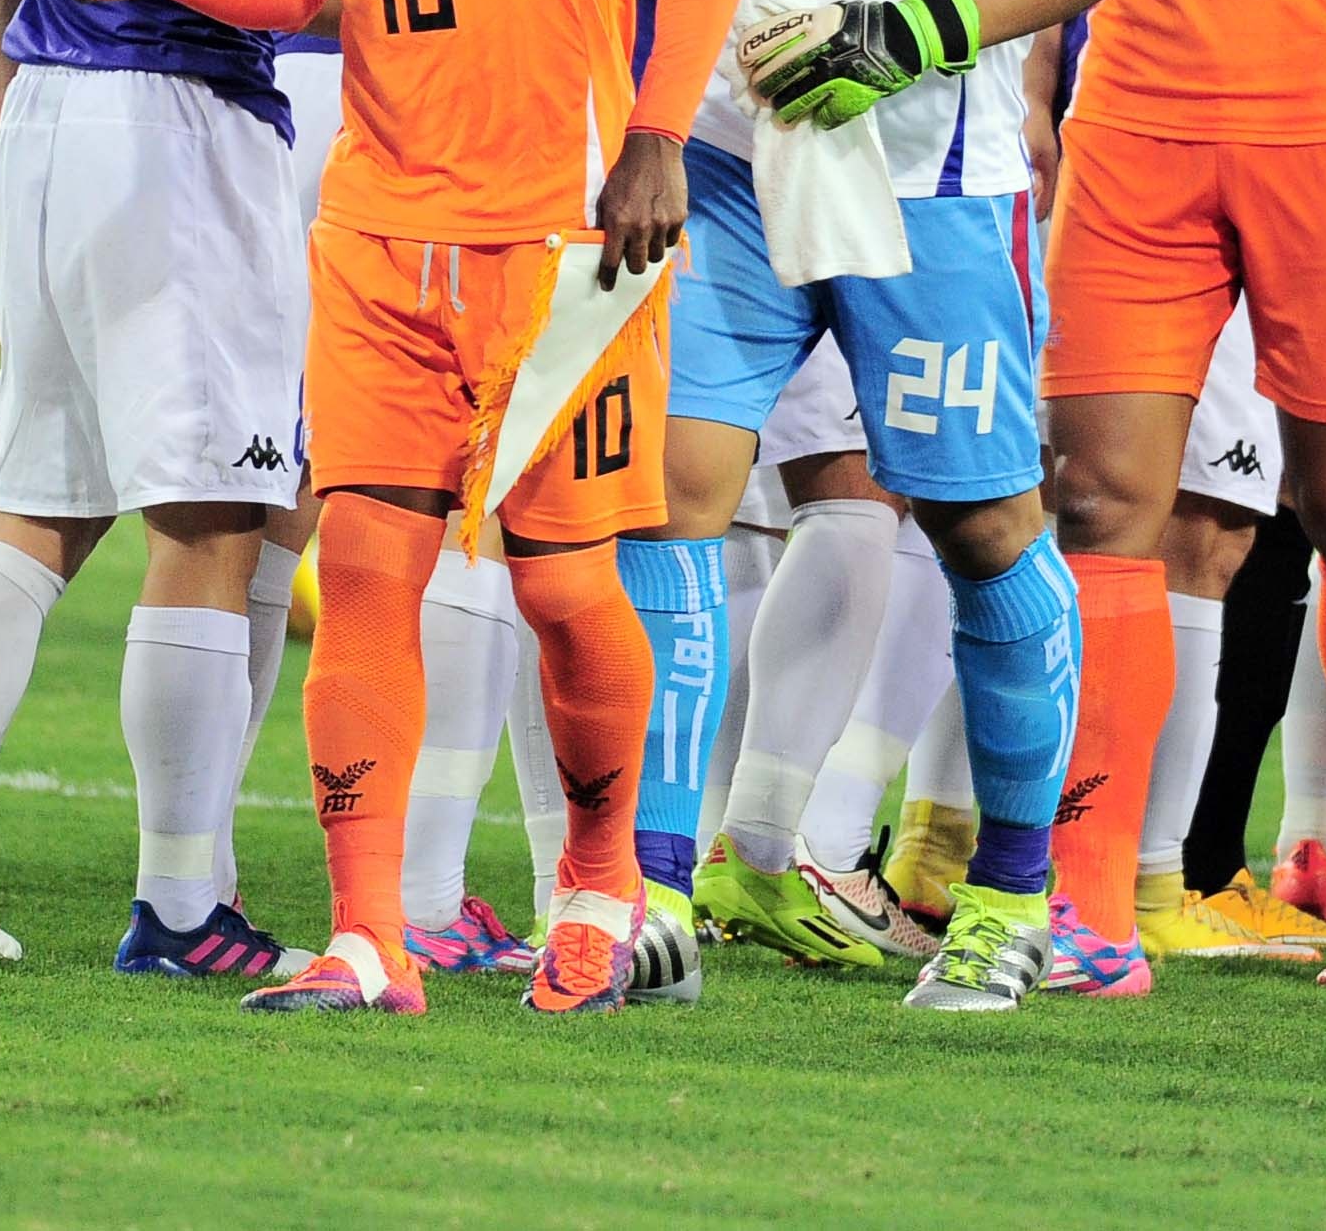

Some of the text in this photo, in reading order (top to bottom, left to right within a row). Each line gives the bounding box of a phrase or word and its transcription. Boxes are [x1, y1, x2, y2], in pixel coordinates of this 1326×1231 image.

[743, 12, 813, 56] reusch
[884, 337, 999, 436] 24
[575, 374, 631, 481] 10
[321, 792, 364, 815] FBT
